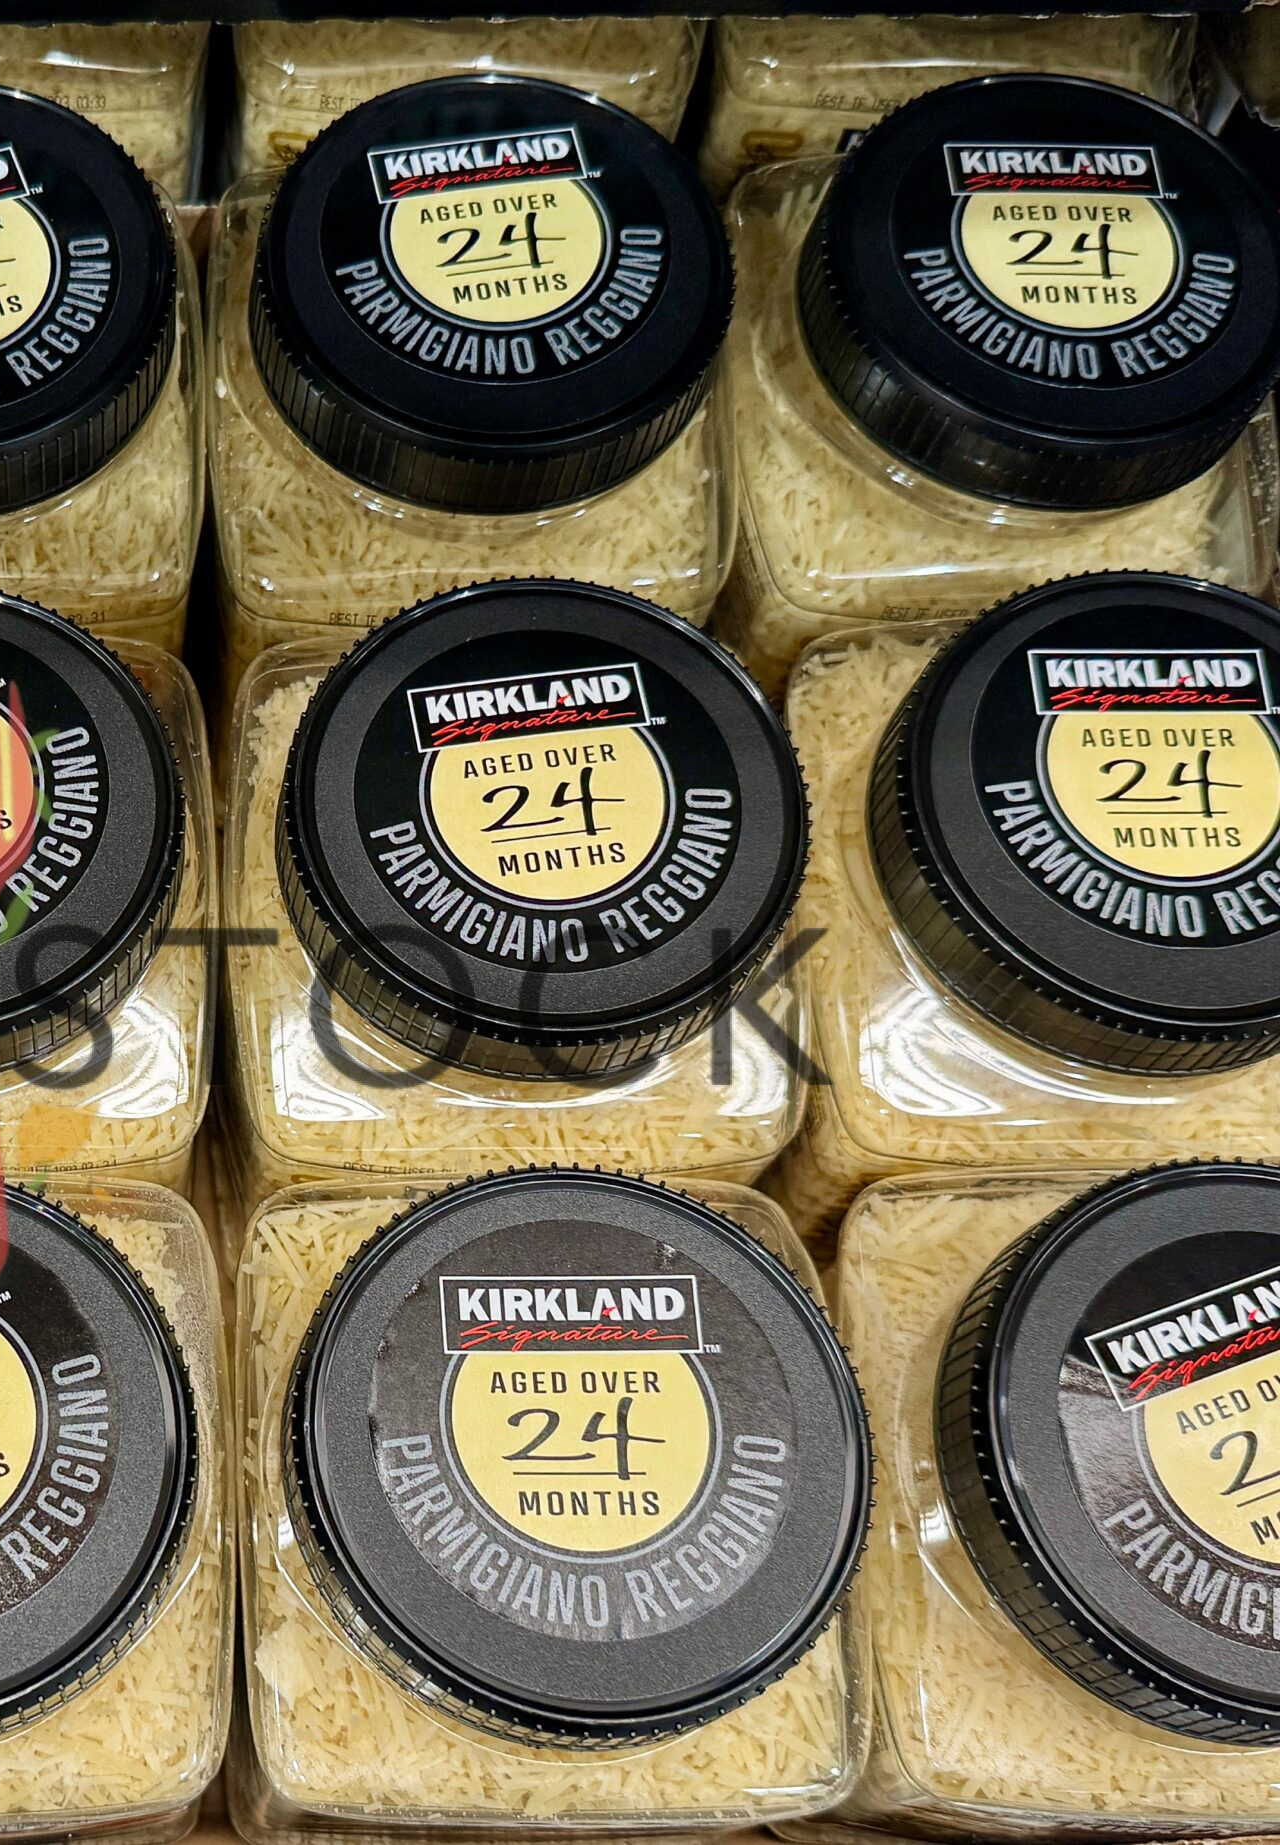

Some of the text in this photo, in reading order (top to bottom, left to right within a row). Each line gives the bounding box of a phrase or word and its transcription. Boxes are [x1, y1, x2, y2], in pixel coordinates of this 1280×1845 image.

[384, 137, 569, 181] KIRKLAND
[960, 151, 1147, 176] KIRKLAND
[390, 163, 575, 197] Signature
[963, 173, 1152, 192] Signature
[420, 193, 558, 224] AGED OVER
[992, 205, 1132, 222] AGED OVER
[436, 212, 566, 269] 24
[1006, 223, 1139, 279] 24
[335, 228, 663, 375] PARMIGIANO REGGIANO
[453, 273, 568, 304] MONTHS
[1021, 286, 1137, 305] MONTHS
[6, 236, 112, 387] REGGIANO
[904, 249, 1236, 380] PARMIGIANO REGGIANO
[329, 613, 358, 626] BEST
[881, 607, 910, 621] BEST
[1045, 659, 1255, 688] KIRKLAND
[425, 674, 632, 724] KIRKLAND
[1050, 688, 1256, 712] Signature
[431, 709, 636, 746] Signature
[1082, 728, 1235, 747] AGED OVER
[464, 743, 616, 778] AGED OVER
[481, 767, 625, 835] 24
[1096, 750, 1243, 818] 24
[5, 726, 100, 912] REGGIANO
[1113, 827, 1242, 848] MONTHS
[369, 787, 733, 964] PARMIGIANO REGGIANO
[498, 842, 625, 876] MONTHS
[984, 780, 1204, 938] PARMIGIANO
[457, 1287, 685, 1322] KIRKLAND
[460, 1322, 689, 1352] Signature
[1107, 1280, 1280, 1375] KIRKLAN
[490, 1371, 661, 1394] AGED OVER
[1176, 1388, 1251, 1435] AGED
[501, 1397, 666, 1481] 24
[1, 1353, 109, 1583] REGGIANO
[519, 1491, 660, 1516] MONTHS
[381, 1434, 787, 1627] PARMIGIANO REGGIANO
